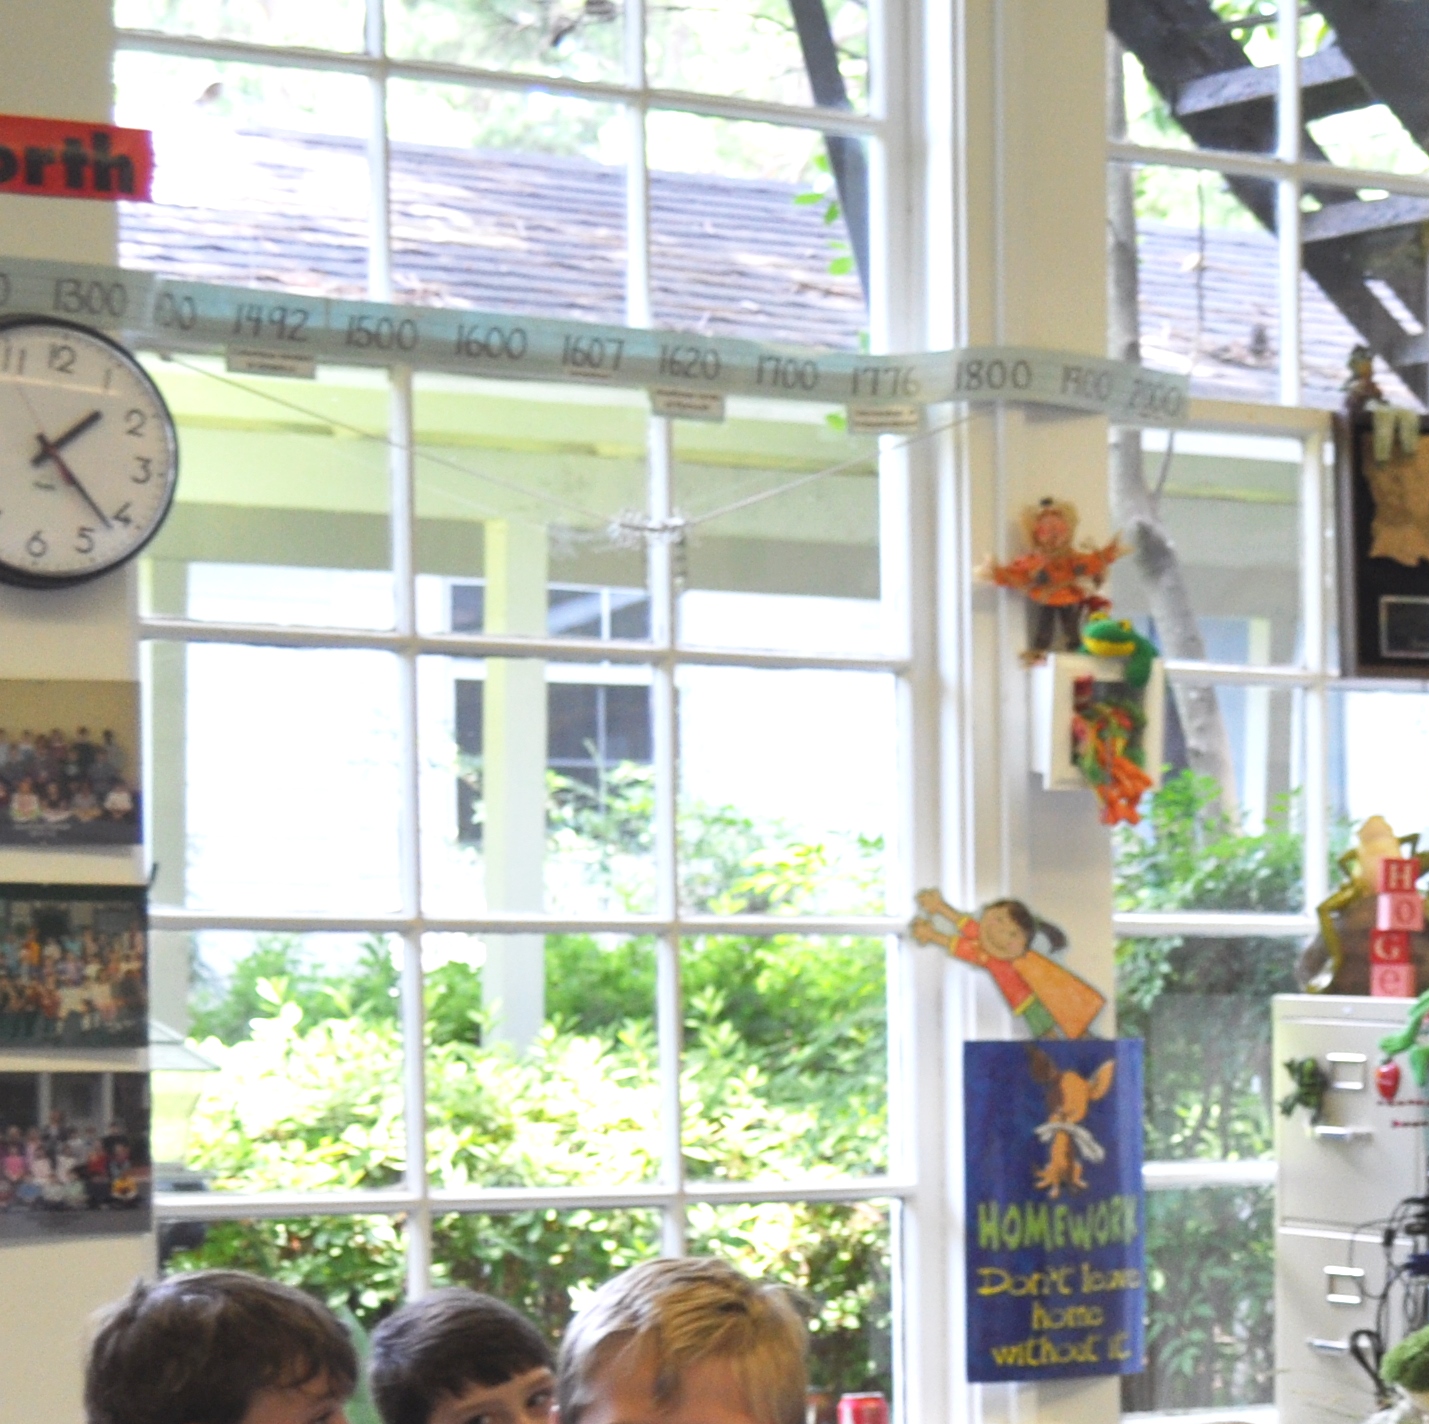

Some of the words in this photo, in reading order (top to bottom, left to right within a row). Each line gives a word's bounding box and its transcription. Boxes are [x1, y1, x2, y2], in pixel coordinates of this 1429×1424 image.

[54, 278, 128, 317] 1300
[233, 304, 309, 342] 1492
[346, 314, 418, 350] 1500
[454, 323, 527, 360] 1600
[563, 334, 625, 372] 1607
[659, 344, 720, 380] 1620
[757, 353, 819, 389] 1700
[850, 365, 921, 397] 1776
[955, 359, 1033, 391] 1800
[49, 345, 77, 374] 12
[102, 369, 112, 390] 1
[125, 409, 147, 436] 2
[132, 457, 153, 484] 3
[26, 530, 47, 557] 6
[75, 527, 94, 554] 5
[977, 1194, 1138, 1251] HOMEWORK
